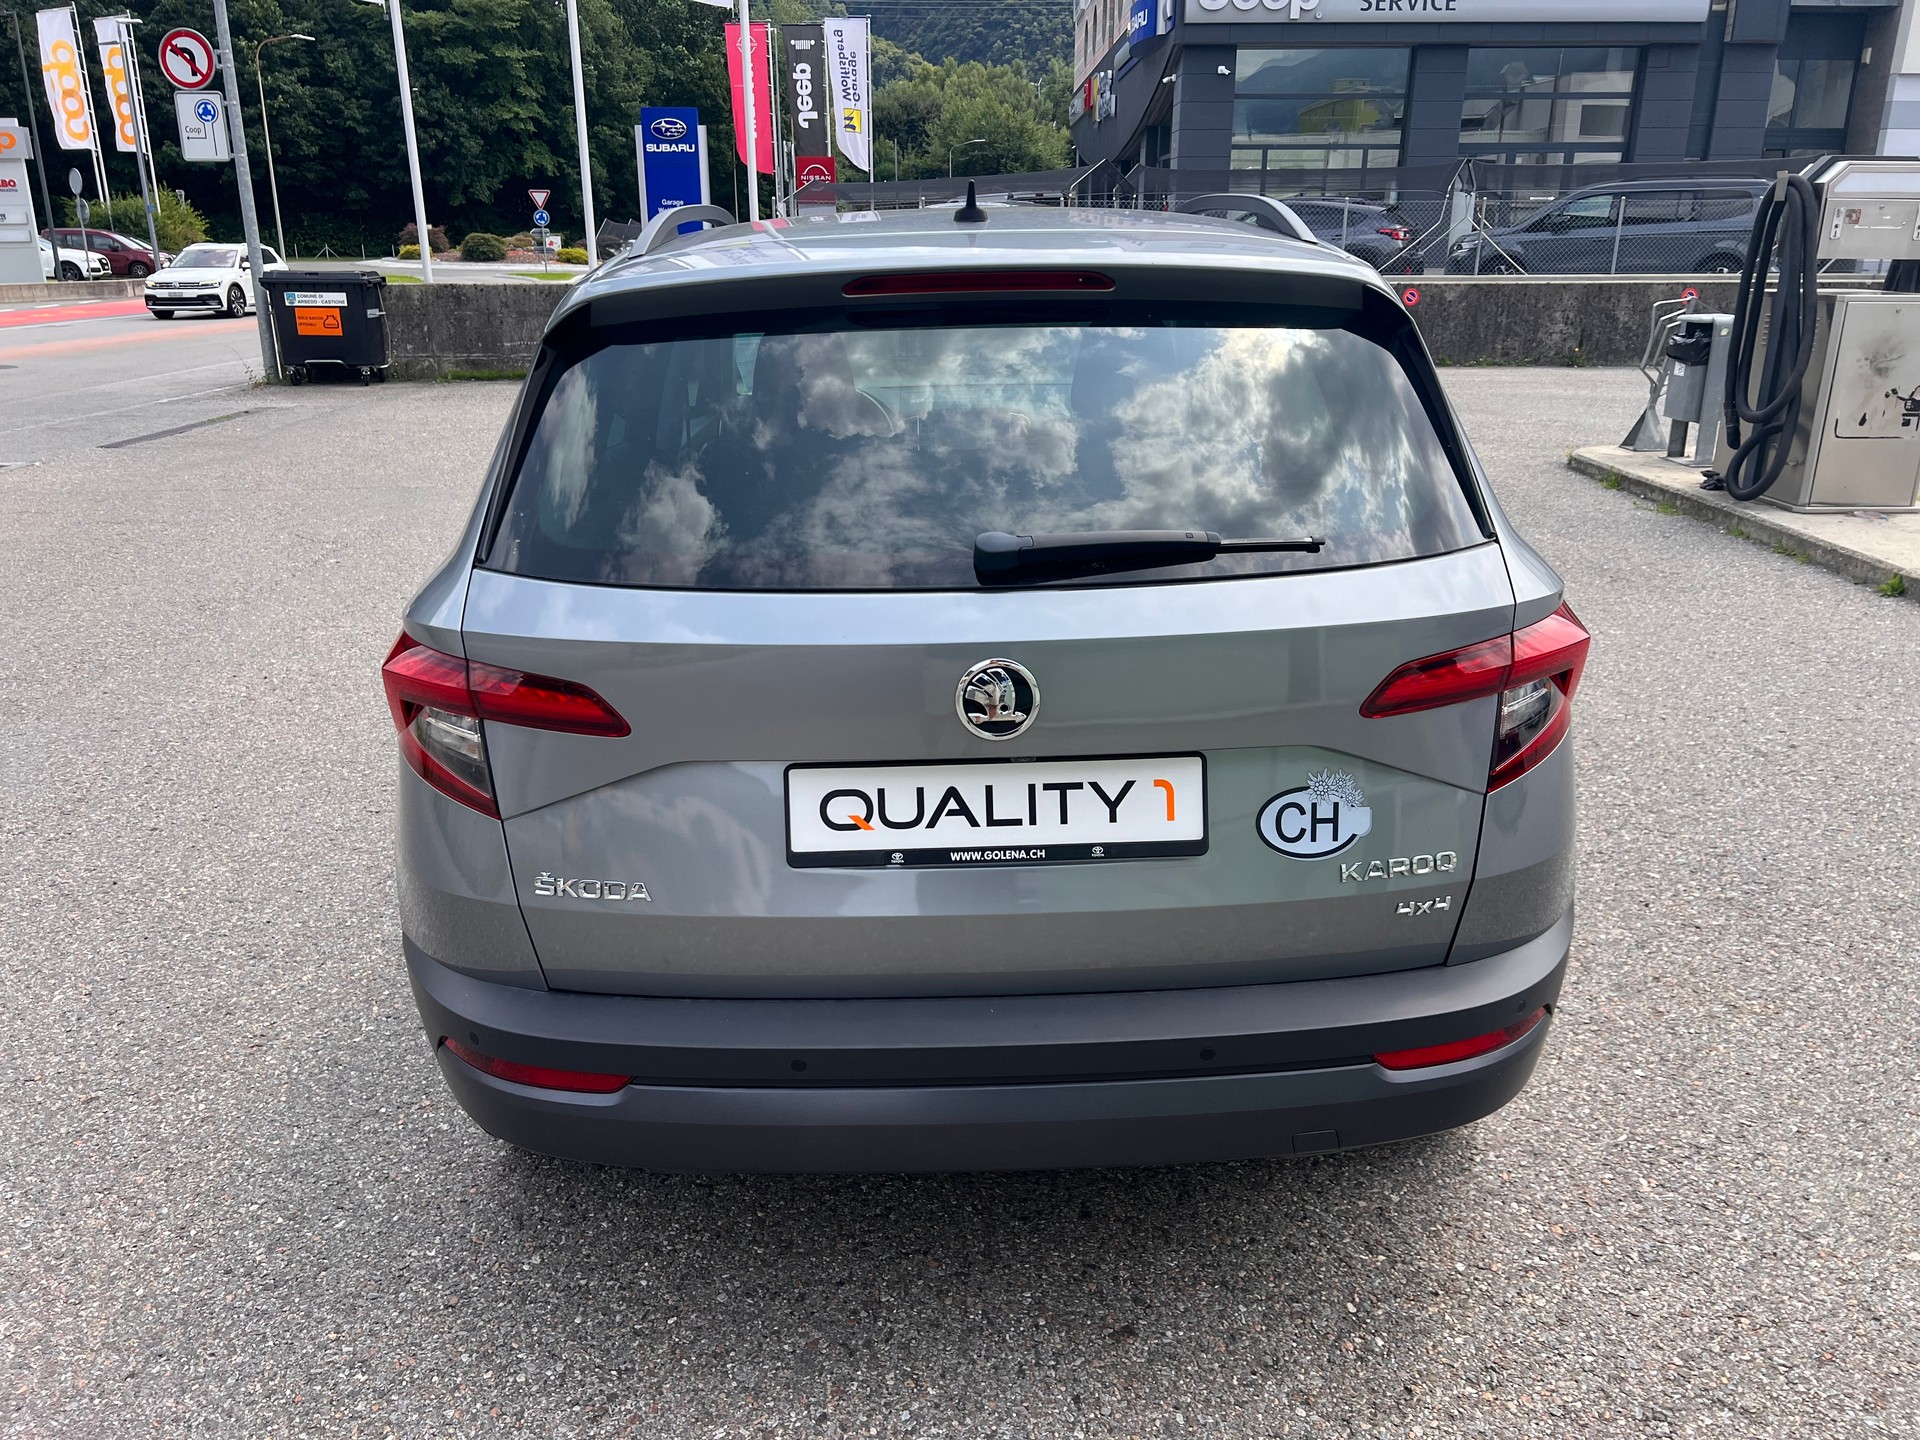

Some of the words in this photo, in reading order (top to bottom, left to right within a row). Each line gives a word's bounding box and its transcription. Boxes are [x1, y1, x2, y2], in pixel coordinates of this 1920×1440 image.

[1360, 0, 1456, 11] SERVICE
[184, 125, 202, 135] Coop
[645, 143, 696, 153] SUBARU
[661, 199, 684, 207] Garage
[819, 779, 1137, 832] QUALITY
[1153, 779, 1175, 822] 1
[1275, 801, 1340, 844] CH
[950, 849, 1046, 862] WWW.GOLENA.CH
[1339, 850, 1459, 884] KAROQ
[534, 871, 652, 902] ŠKODA
